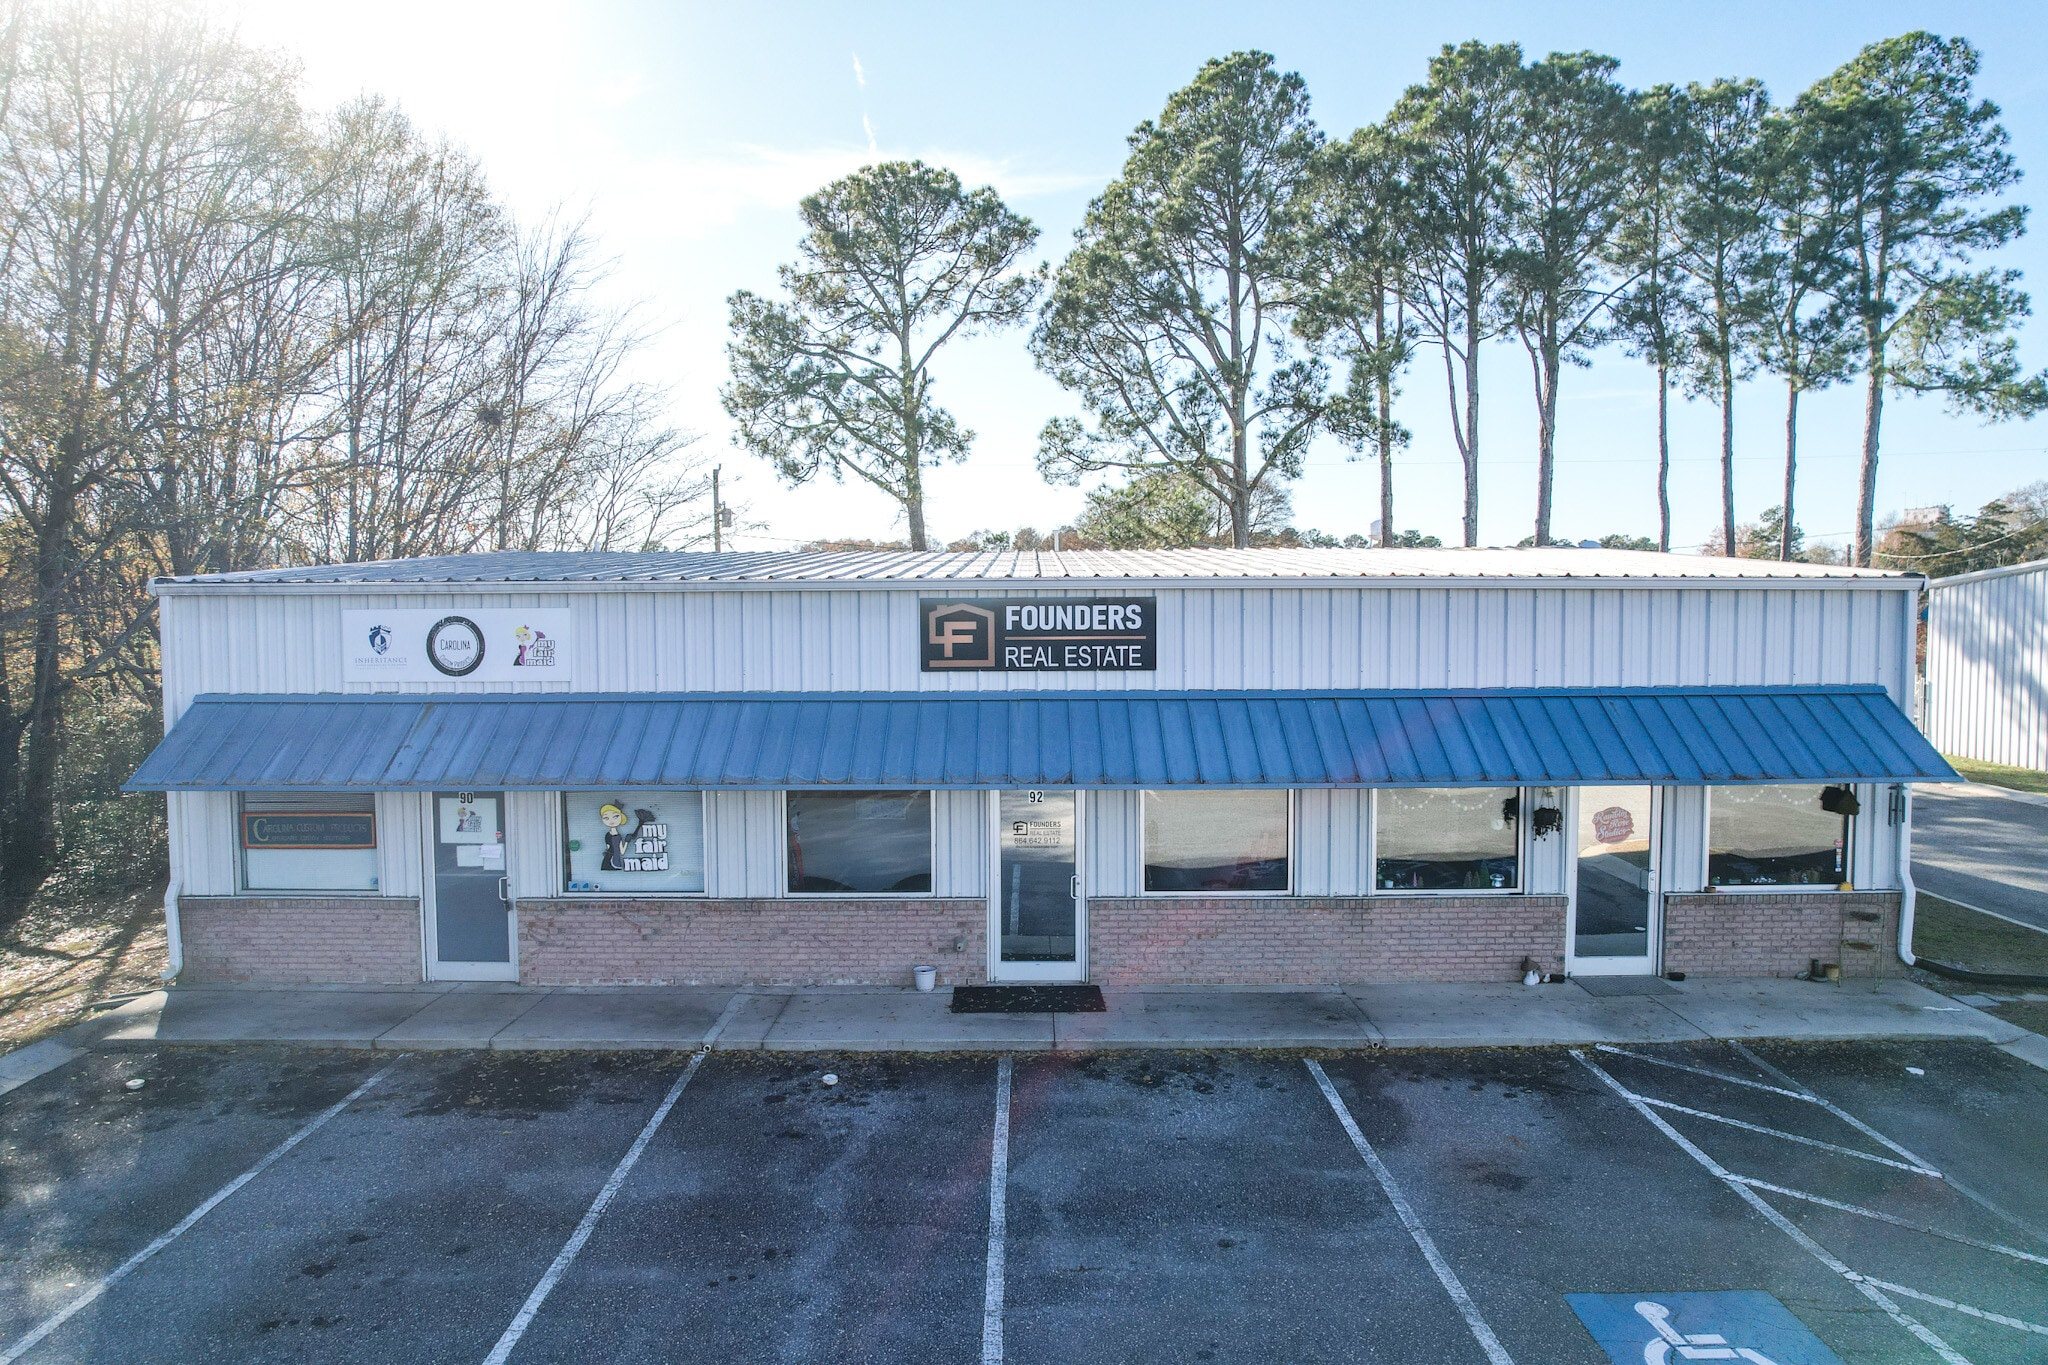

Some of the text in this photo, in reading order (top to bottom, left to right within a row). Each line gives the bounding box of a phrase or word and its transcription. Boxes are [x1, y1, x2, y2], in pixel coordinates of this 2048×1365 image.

[1005, 604, 1142, 631] FOUNDERS
[440, 639, 471, 651] CAROLINA
[536, 639, 555, 651] my
[532, 648, 555, 658] fair
[1005, 645, 1142, 667] REAL ESTATE
[526, 655, 555, 667] maid
[460, 792, 473, 804] 90
[1029, 791, 1043, 803] 92
[642, 824, 667, 839] my
[634, 837, 667, 854] fair
[623, 852, 669, 872] maid
